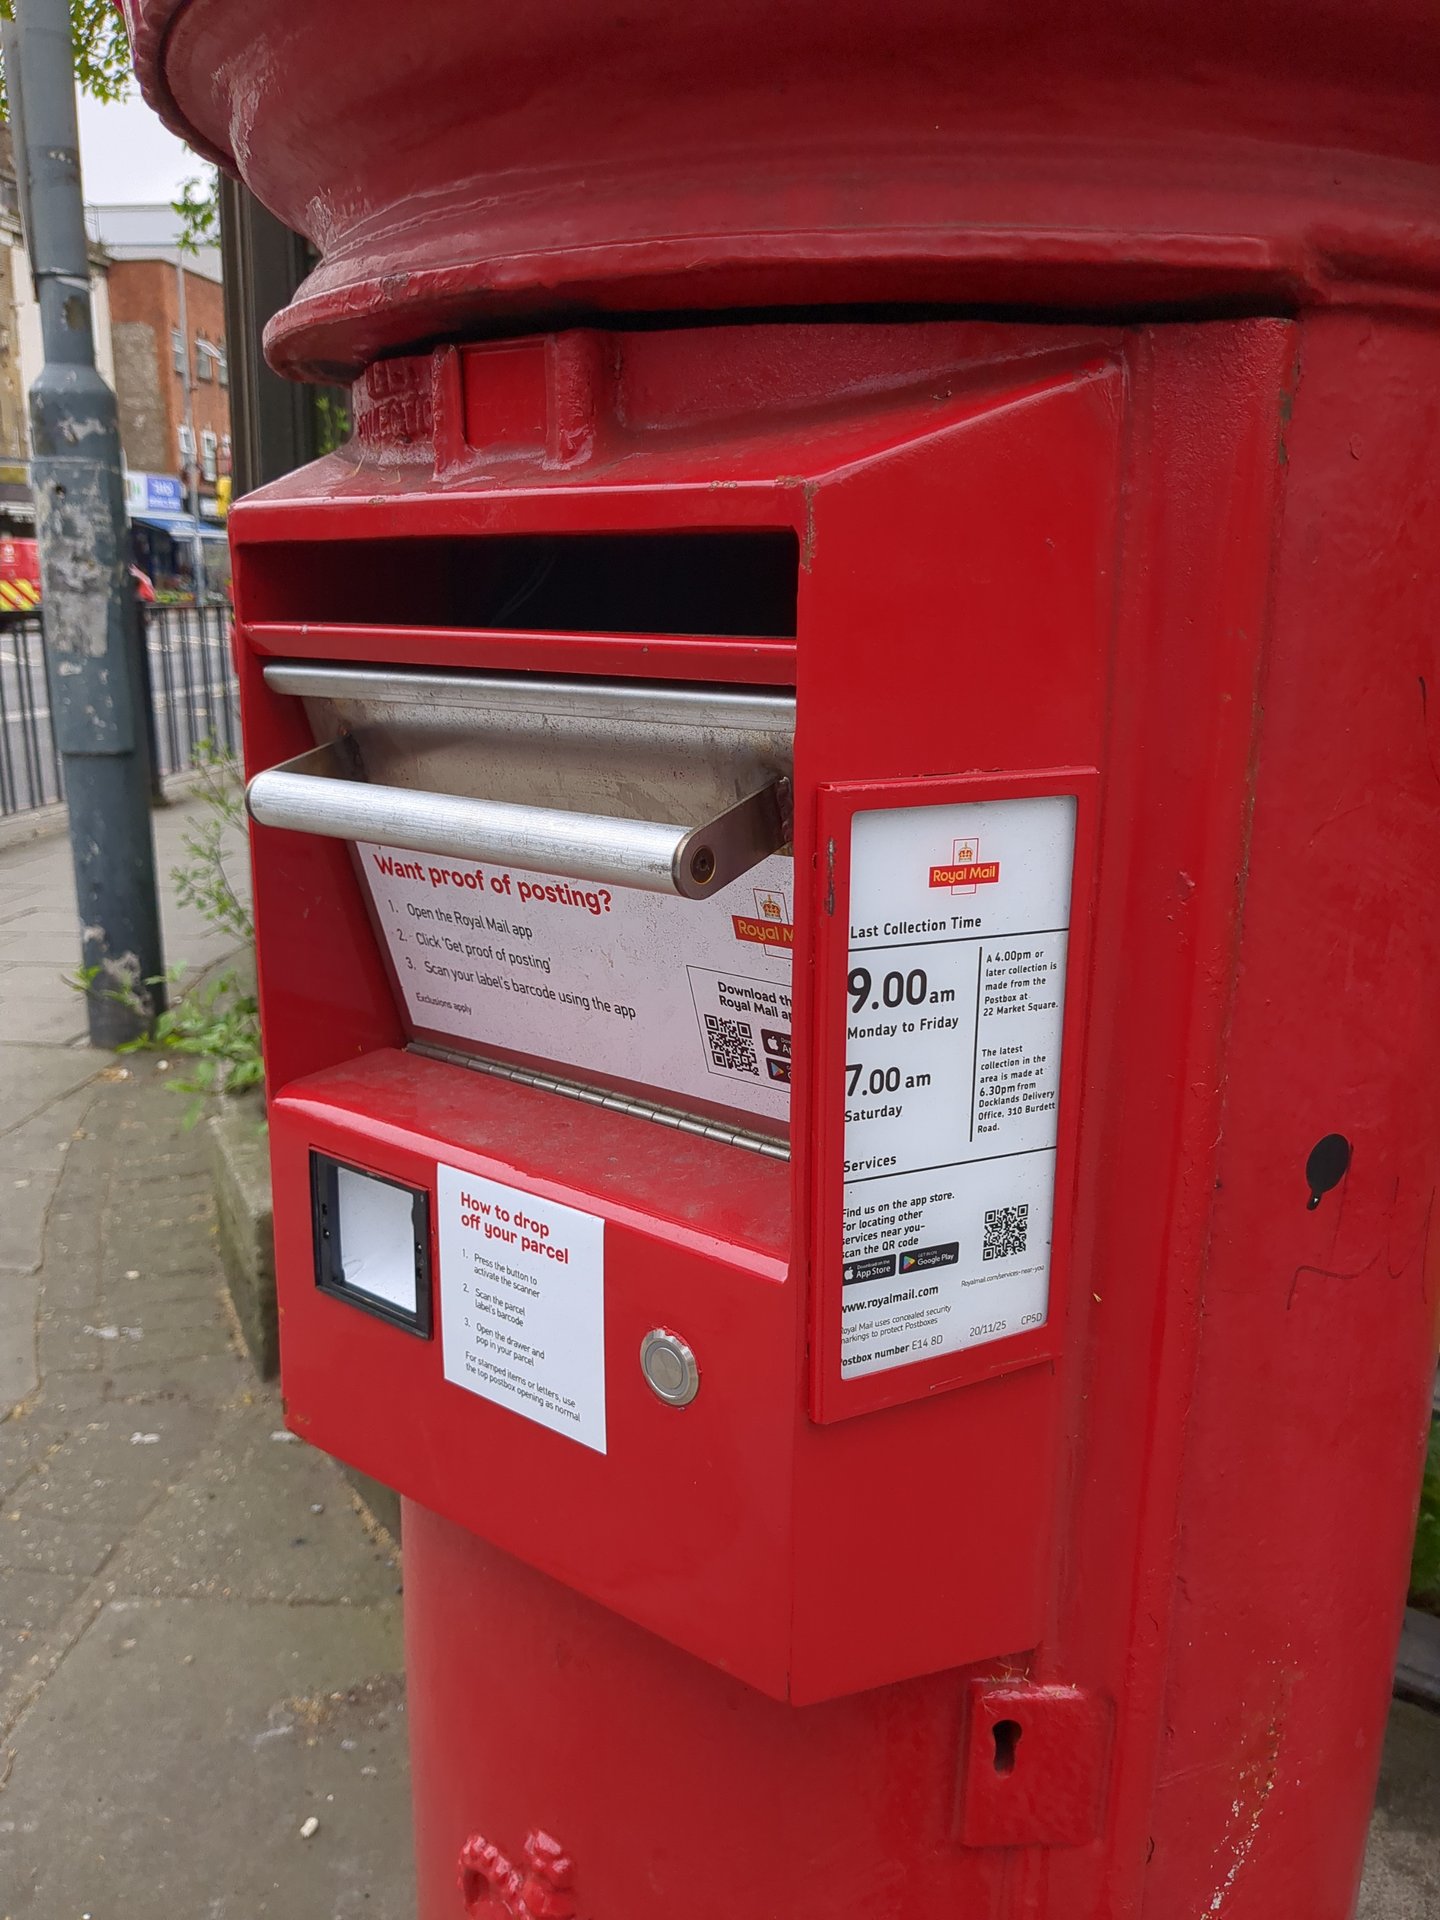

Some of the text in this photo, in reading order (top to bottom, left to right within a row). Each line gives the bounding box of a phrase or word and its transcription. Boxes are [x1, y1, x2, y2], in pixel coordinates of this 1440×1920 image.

[373, 854, 611, 915] Want proof of posting?
[933, 866, 996, 883] Royal Mail
[389, 900, 532, 939] 1. Open the Royal Mail app
[850, 916, 982, 939] Last Collection Time
[738, 920, 779, 941] Royal
[397, 929, 407, 941] 2.
[416, 933, 441, 948] Click
[466, 943, 492, 959] proof
[496, 949, 505, 961] of
[986, 954, 992, 963] A
[995, 950, 1031, 963] 4.00pm
[986, 962, 1057, 977] later collection is
[405, 957, 636, 1019] 3. Scan your label's barcode using the app
[717, 982, 776, 1004] Download
[985, 977, 1046, 991] made from the
[416, 992, 472, 1015] Exclusions apply
[718, 995, 751, 1011] Royal
[754, 1003, 779, 1018] Mail
[983, 1000, 1058, 1016] 22 Market Square.
[985, 994, 1016, 1004] Postbox
[848, 1016, 959, 1039] Monday to Friday
[982, 1045, 1023, 1057] The latest
[980, 1055, 1046, 1070] collection in the
[980, 1068, 1043, 1084] area is made at
[979, 1081, 1036, 1098] 6.30pm from
[979, 1090, 1055, 1108] Docklands Delivery
[845, 1104, 903, 1122] Saturday
[978, 1102, 1055, 1120] Office, 310 Burdett
[978, 1123, 1000, 1133] Road.
[844, 1155, 897, 1172] Services
[864, 1204, 875, 1214] us
[878, 1202, 890, 1212] on
[892, 1199, 907, 1209] the
[910, 1196, 927, 1208] app
[929, 1192, 955, 1203] store.
[461, 1192, 550, 1238] How to drop
[859, 1214, 896, 1229] locating
[898, 1210, 923, 1222] other
[461, 1214, 569, 1264] off your parcel
[881, 1229, 902, 1239] near
[864, 1243, 879, 1254] the
[882, 1240, 895, 1251] QR
[898, 1237, 919, 1248] code
[474, 1253, 493, 1268] Press
[494, 1260, 505, 1273] the
[506, 1265, 528, 1281] button
[530, 1276, 537, 1285] to
[918, 1256, 940, 1265] Google
[942, 1253, 954, 1261] Play
[474, 1266, 540, 1298] activate the scanner
[856, 1266, 890, 1278] App Store
[475, 1289, 525, 1316] Scan the parcel
[497, 1310, 524, 1327] barcode
[859, 1320, 874, 1331] Mail
[875, 1317, 890, 1327] uses
[892, 1310, 924, 1323] concealed
[926, 1305, 952, 1317] security
[871, 1329, 878, 1337] to
[880, 1325, 903, 1337] protect
[905, 1317, 938, 1330] Postboxes
[970, 1320, 1006, 1336] 20/11/25
[476, 1323, 493, 1336] Open
[495, 1329, 505, 1342] the
[506, 1335, 530, 1352] drawer
[531, 1346, 544, 1359] and
[476, 1336, 534, 1366] pop in your parcel
[842, 1335, 943, 1366] ostbox number E14 8D
[465, 1351, 575, 1407] For stamped items or letters, use
[466, 1363, 581, 1422] the top postbox opening as normal
